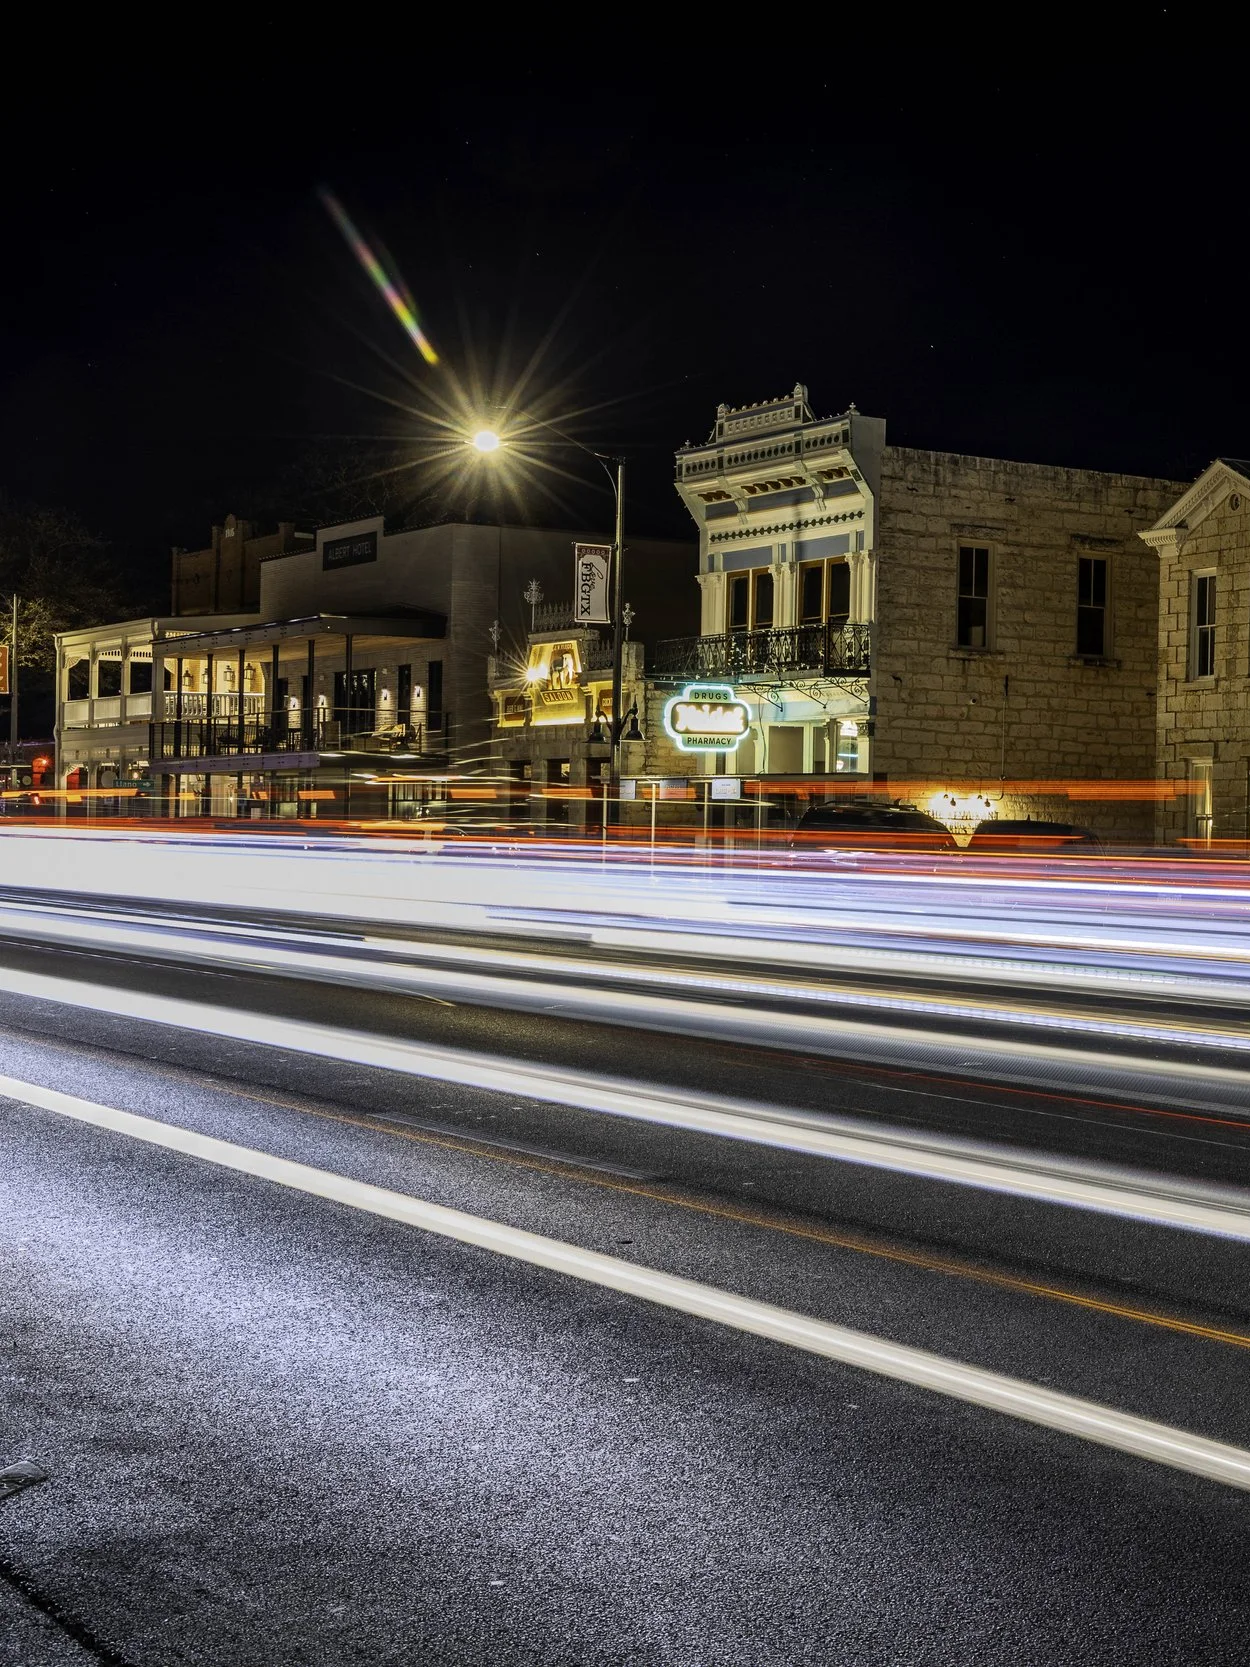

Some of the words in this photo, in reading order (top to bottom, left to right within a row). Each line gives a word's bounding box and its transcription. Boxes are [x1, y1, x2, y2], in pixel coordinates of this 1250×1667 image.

[328, 546, 351, 561] ALBERT
[352, 542, 372, 557] HOTEL
[581, 561, 591, 616] FBGTX
[544, 690, 574, 703] SALOON
[694, 692, 728, 700] DRUGS
[687, 737, 732, 745] PHARMACY
[115, 780, 138, 788] Llano
